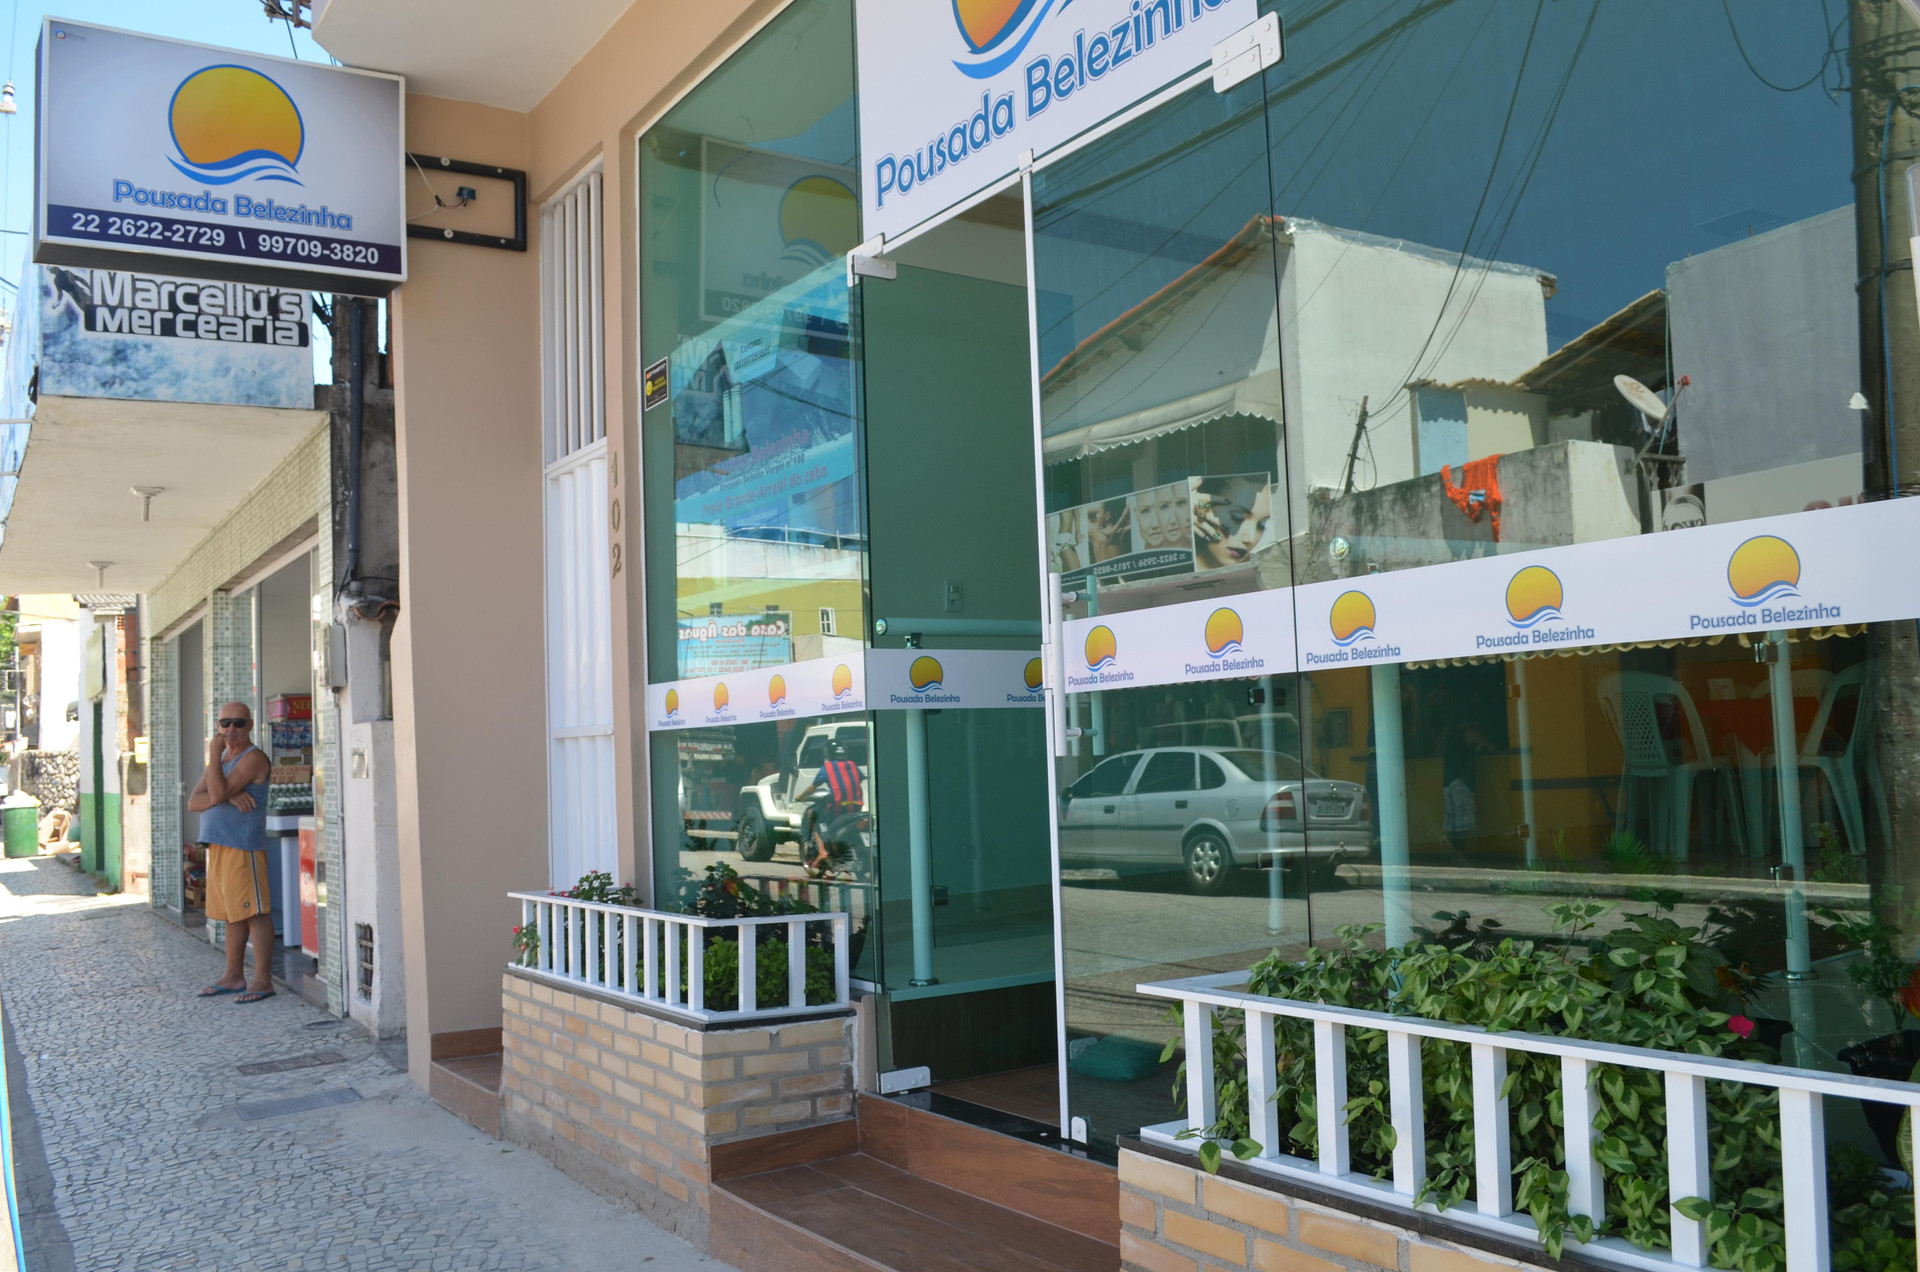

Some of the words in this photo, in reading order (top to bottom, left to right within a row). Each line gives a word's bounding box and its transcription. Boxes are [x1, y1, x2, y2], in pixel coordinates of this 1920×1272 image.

[876, 89, 1015, 209] Pousada
[113, 179, 228, 215] Pousada
[234, 193, 353, 231] Belezinha
[72, 212, 100, 235] 22
[107, 216, 226, 248] 2622-2729
[257, 234, 379, 266] 99709-3820
[92, 270, 304, 322] Marcellu's
[95, 306, 300, 346] Mercearia
[702, 500, 723, 516] Praia
[789, 469, 802, 488] do
[804, 462, 828, 482] cabo
[1690, 612, 1757, 631] Pousada
[1761, 603, 1841, 624] Belezinha
[1476, 631, 1529, 649] Pousada
[1532, 625, 1595, 643] Belezinha
[1184, 660, 1220, 675] Pousada
[1222, 657, 1264, 672] Belezinha
[1306, 649, 1349, 665] Pousada
[1351, 645, 1402, 660] Belezinha
[1068, 671, 1098, 686] Pousada
[1099, 670, 1134, 684] Belezinha
[821, 703, 840, 712] Pousada
[841, 700, 863, 710] Belezinha
[890, 694, 923, 703] Pousada
[925, 693, 960, 703] Belezinha
[1007, 693, 1037, 702] Pousada
